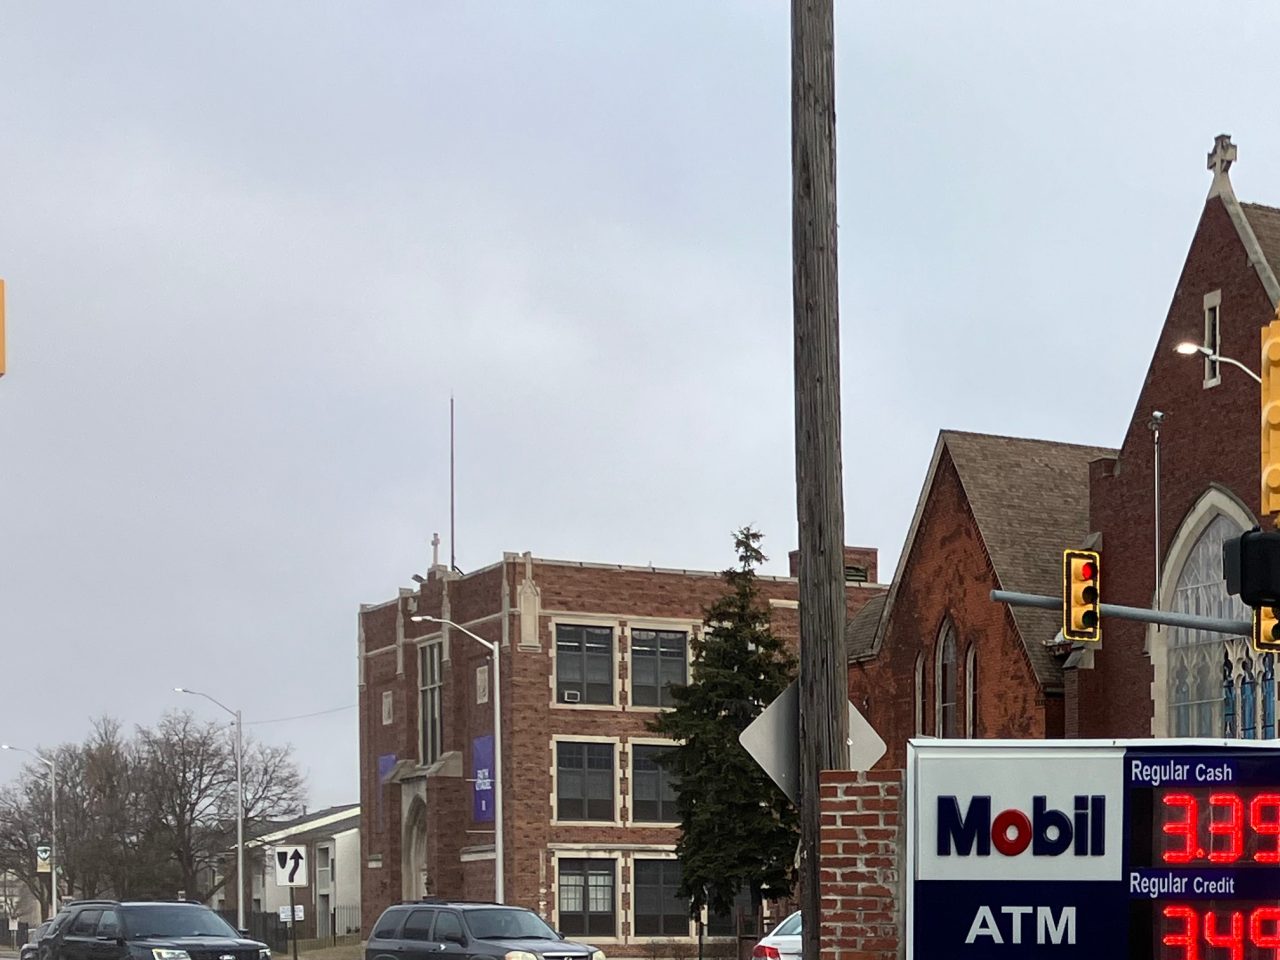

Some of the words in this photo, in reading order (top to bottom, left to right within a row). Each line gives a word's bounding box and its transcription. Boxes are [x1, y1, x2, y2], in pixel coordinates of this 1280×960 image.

[1131, 760, 1190, 785] Regular
[1195, 764, 1233, 781] Cash
[937, 795, 1106, 856] Mobil
[1130, 872, 1188, 897] Regular
[1193, 876, 1235, 893] Credit
[965, 905, 1077, 945] ATM
